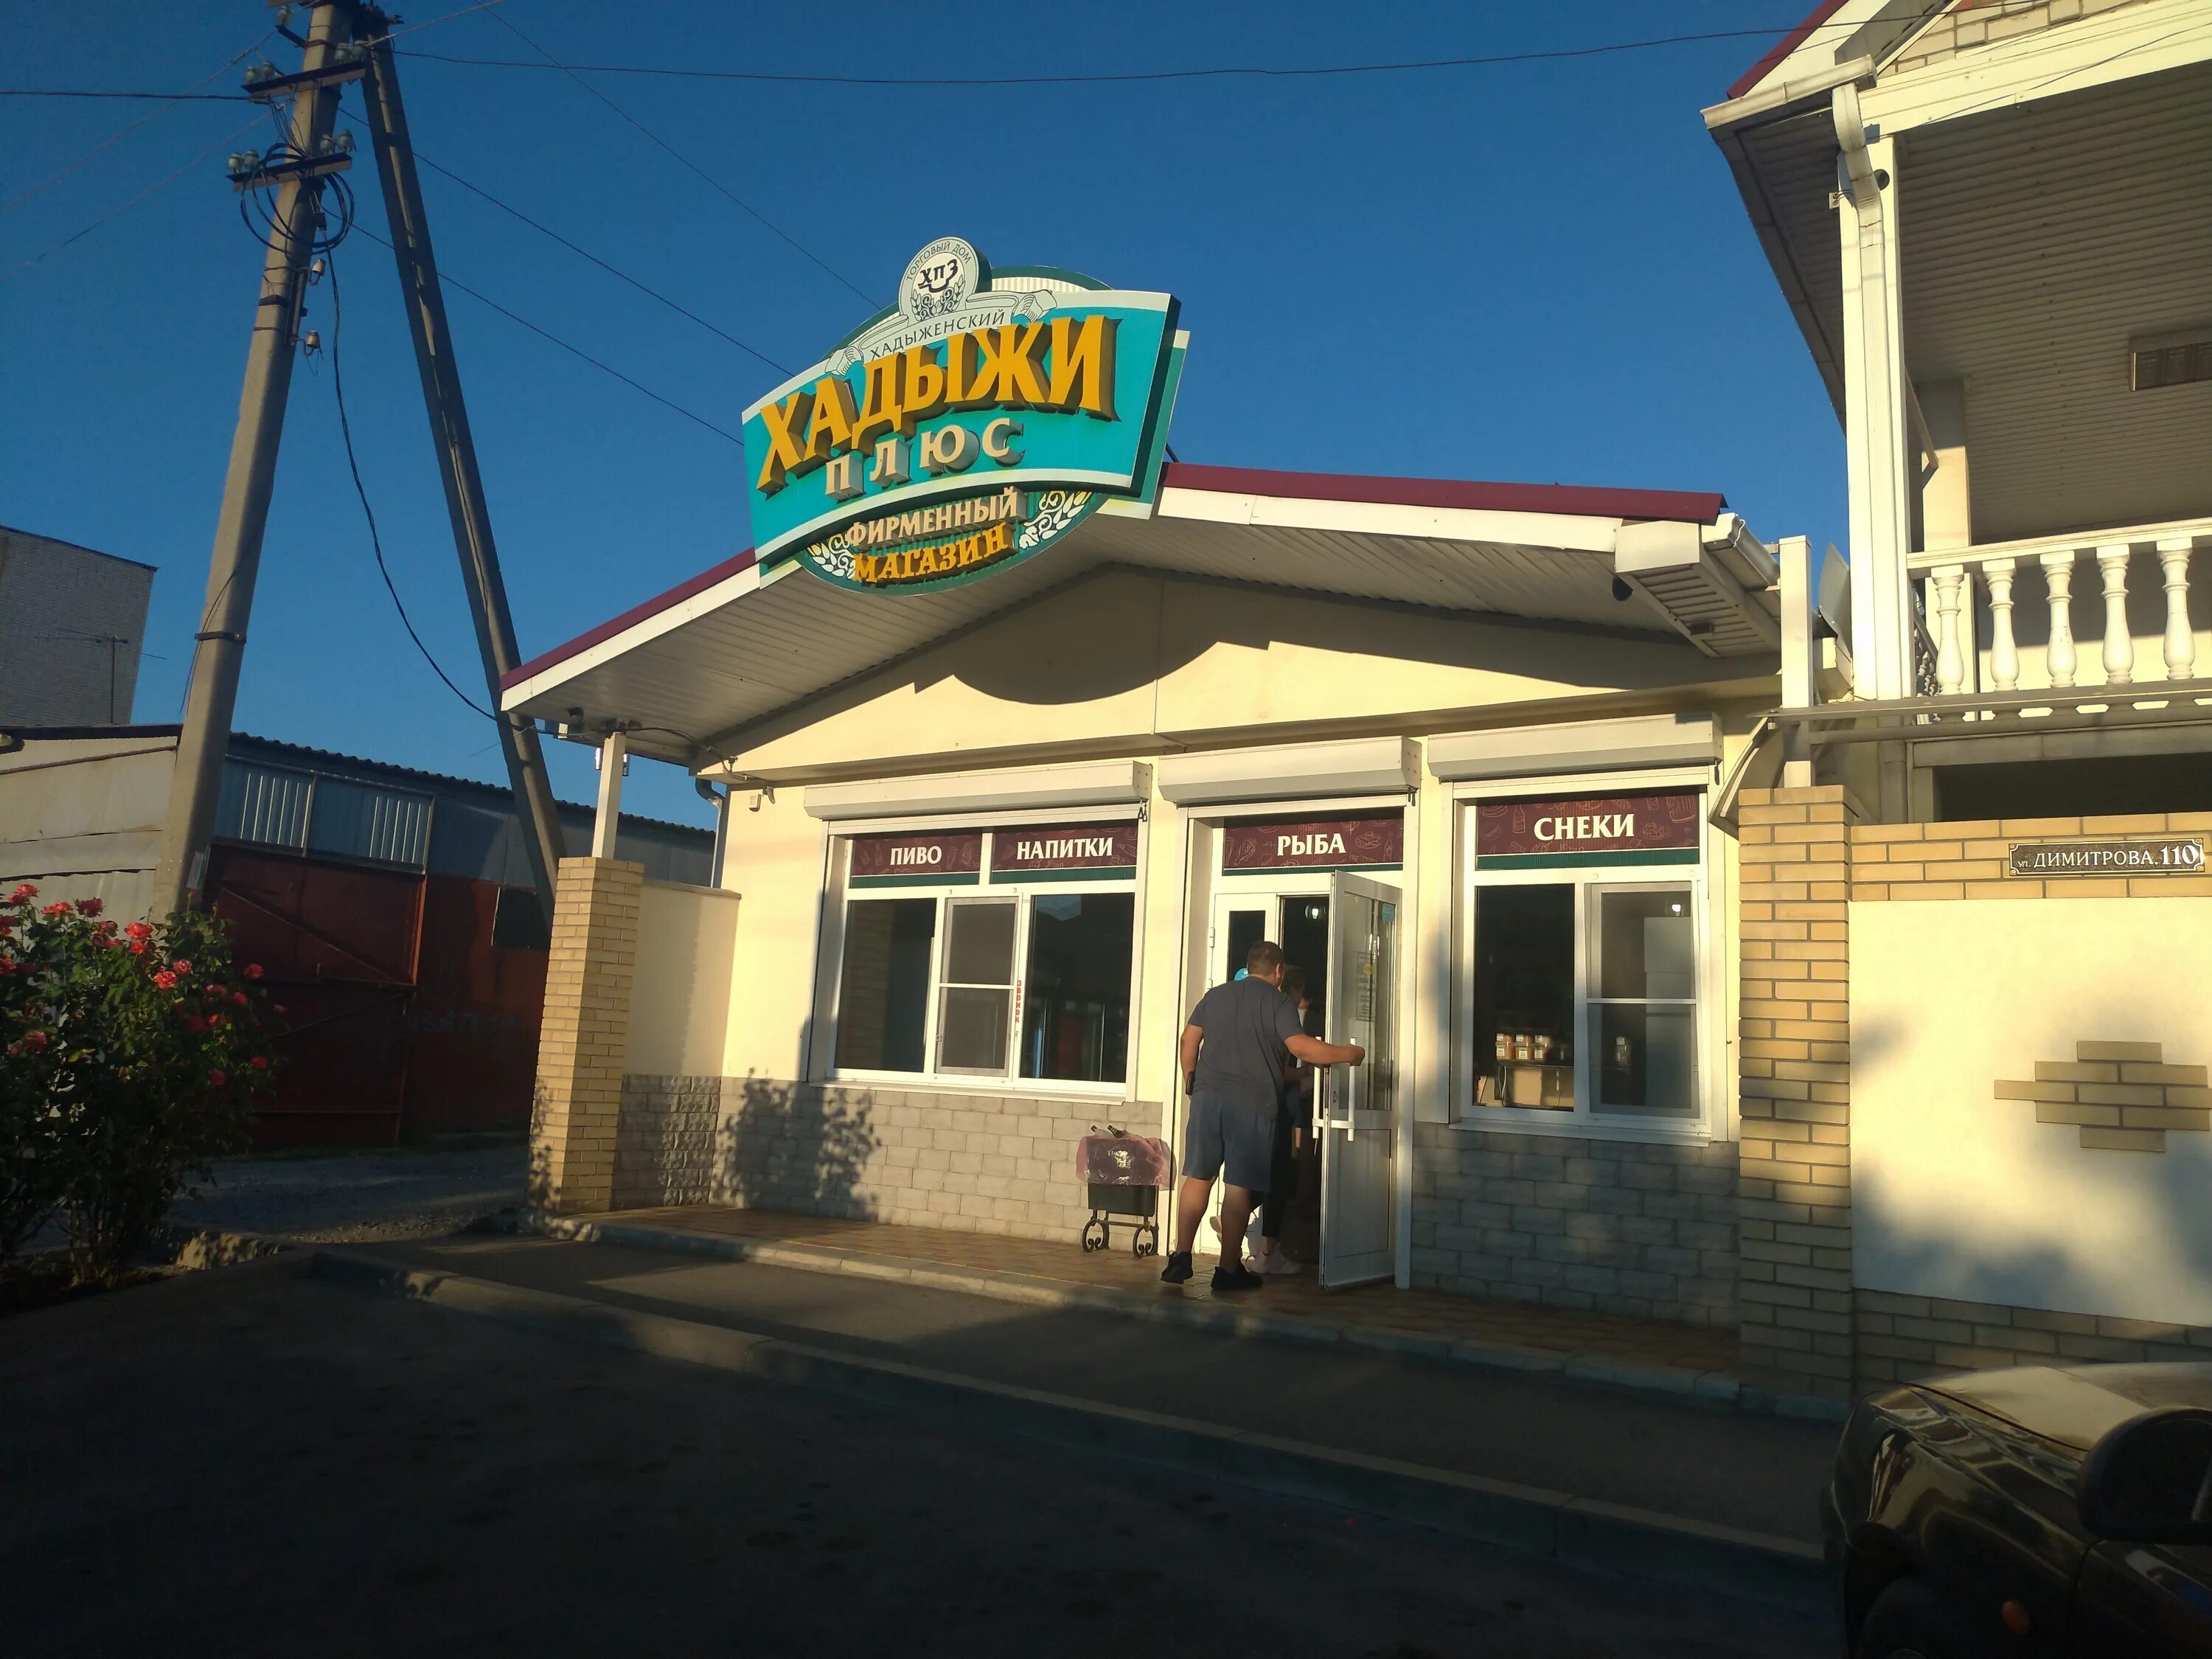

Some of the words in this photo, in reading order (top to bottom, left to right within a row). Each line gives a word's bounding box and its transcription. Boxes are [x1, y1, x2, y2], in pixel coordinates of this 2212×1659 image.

[906, 241, 951, 280] ТОРГОВЫЙ
[952, 243, 972, 264] ДОМ
[870, 308, 1006, 361] ХАДЫЖЕНСКИЙ
[756, 315, 1107, 493] ХАДЫЖИ
[826, 418, 1013, 498] ПЛЮС
[847, 486, 1018, 547] ФИРМЕННЫЙ
[853, 521, 1009, 582] МАГАЗИН
[1276, 833, 1347, 856] РЫБА
[1534, 813, 1635, 841] СНЕКИ
[890, 846, 942, 866] ПИВО
[1015, 837, 1114, 860] НАПИТКИ
[2017, 860, 2031, 869] ул.
[2160, 845, 2199, 866] 110
